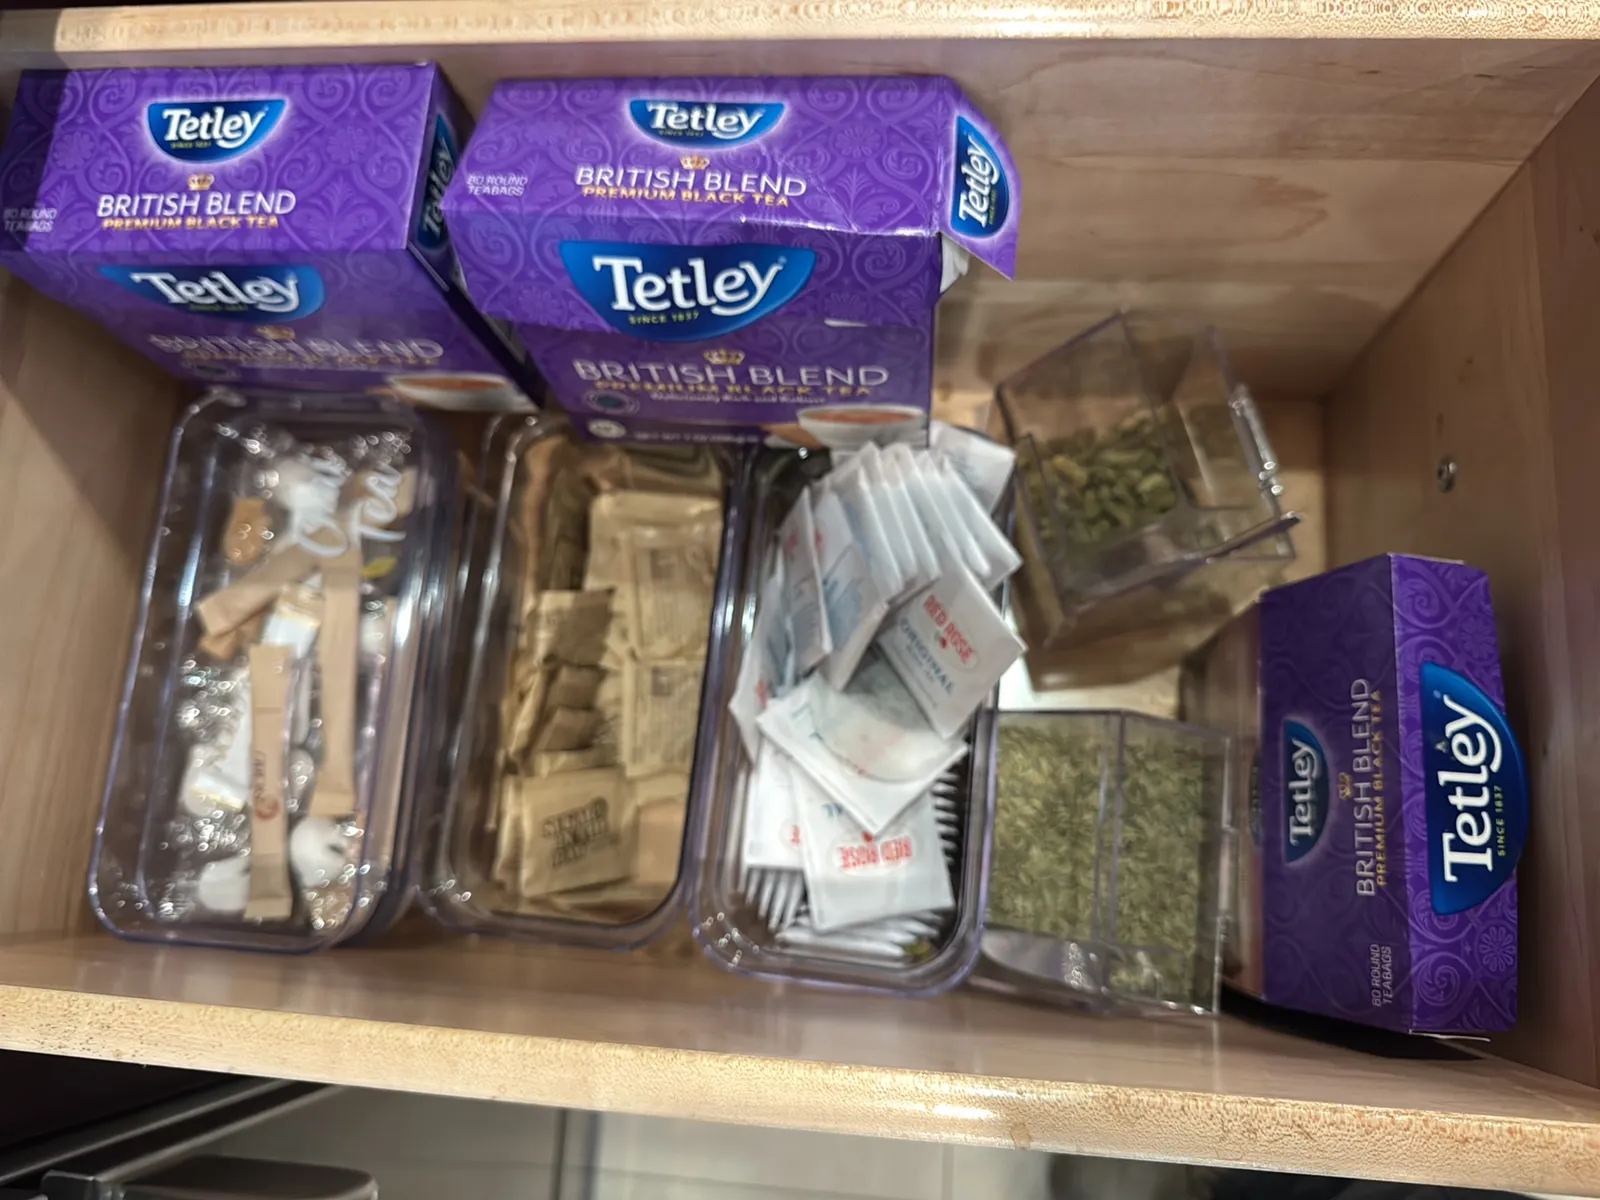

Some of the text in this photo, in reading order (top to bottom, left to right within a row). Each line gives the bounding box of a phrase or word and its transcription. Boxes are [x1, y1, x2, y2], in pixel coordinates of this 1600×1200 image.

[162, 106, 266, 149] Tetley
[645, 100, 764, 140] Tetley
[468, 186, 525, 197] TEABAGS
[575, 163, 807, 197] BRITISH BLEND
[582, 186, 788, 207] PREMIUM BLACK TEA
[959, 133, 1000, 228] Tetley
[97, 189, 296, 218] BRITISH BLEND
[102, 214, 279, 231] PREMIUM BLACK TEA
[130, 271, 299, 313] Tetley
[592, 255, 784, 316] Tetley
[572, 359, 890, 387] BRITISH BLEND
[943, 622, 977, 666] ROSE
[1289, 737, 1321, 847] Tetley
[1350, 678, 1376, 897] BRITISH BLEND
[1371, 690, 1388, 887] PREMIUM BLACK TEA
[1438, 693, 1503, 884] Tetley
[1496, 818, 1506, 857] SINCE
[1370, 944, 1381, 989] ROUND
[1381, 946, 1393, 1005] TEABAGS
